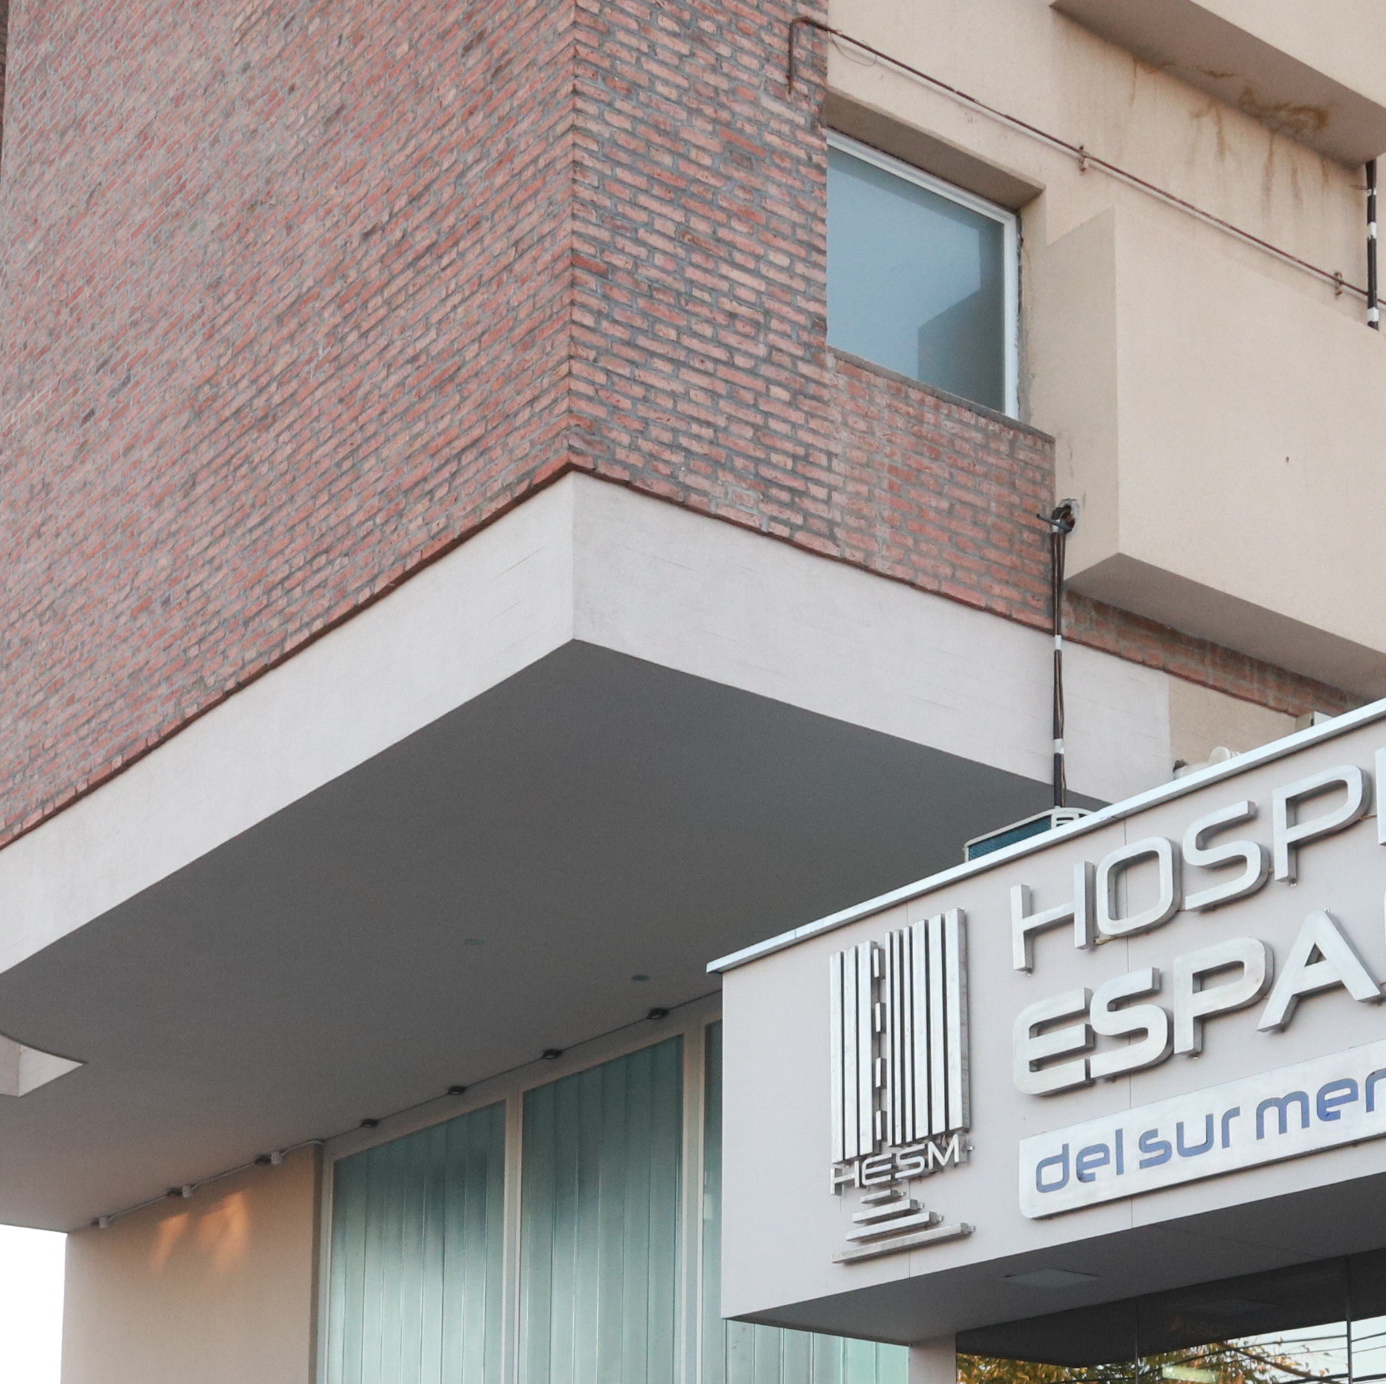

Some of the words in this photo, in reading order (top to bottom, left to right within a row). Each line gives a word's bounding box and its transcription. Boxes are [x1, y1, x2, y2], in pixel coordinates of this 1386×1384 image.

[830, 1132, 969, 1197] HESM
[1035, 1126, 1125, 1194] del
[1139, 1105, 1242, 1169] sur
